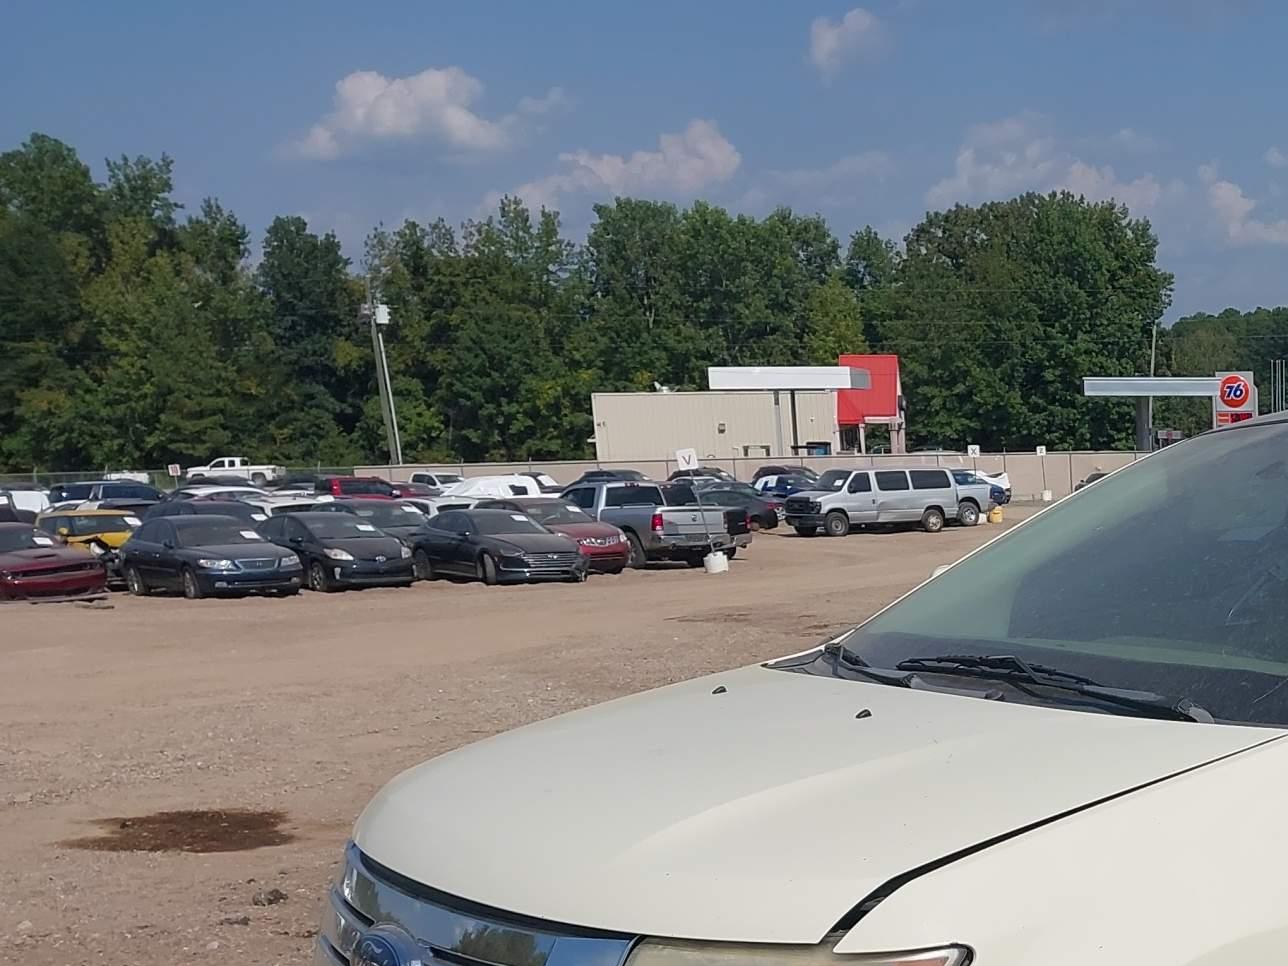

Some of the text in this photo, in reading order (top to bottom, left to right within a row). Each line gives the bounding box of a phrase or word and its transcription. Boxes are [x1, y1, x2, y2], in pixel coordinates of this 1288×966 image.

[1224, 382, 1245, 400] 76
[970, 447, 977, 456] X
[681, 454, 691, 466] V
